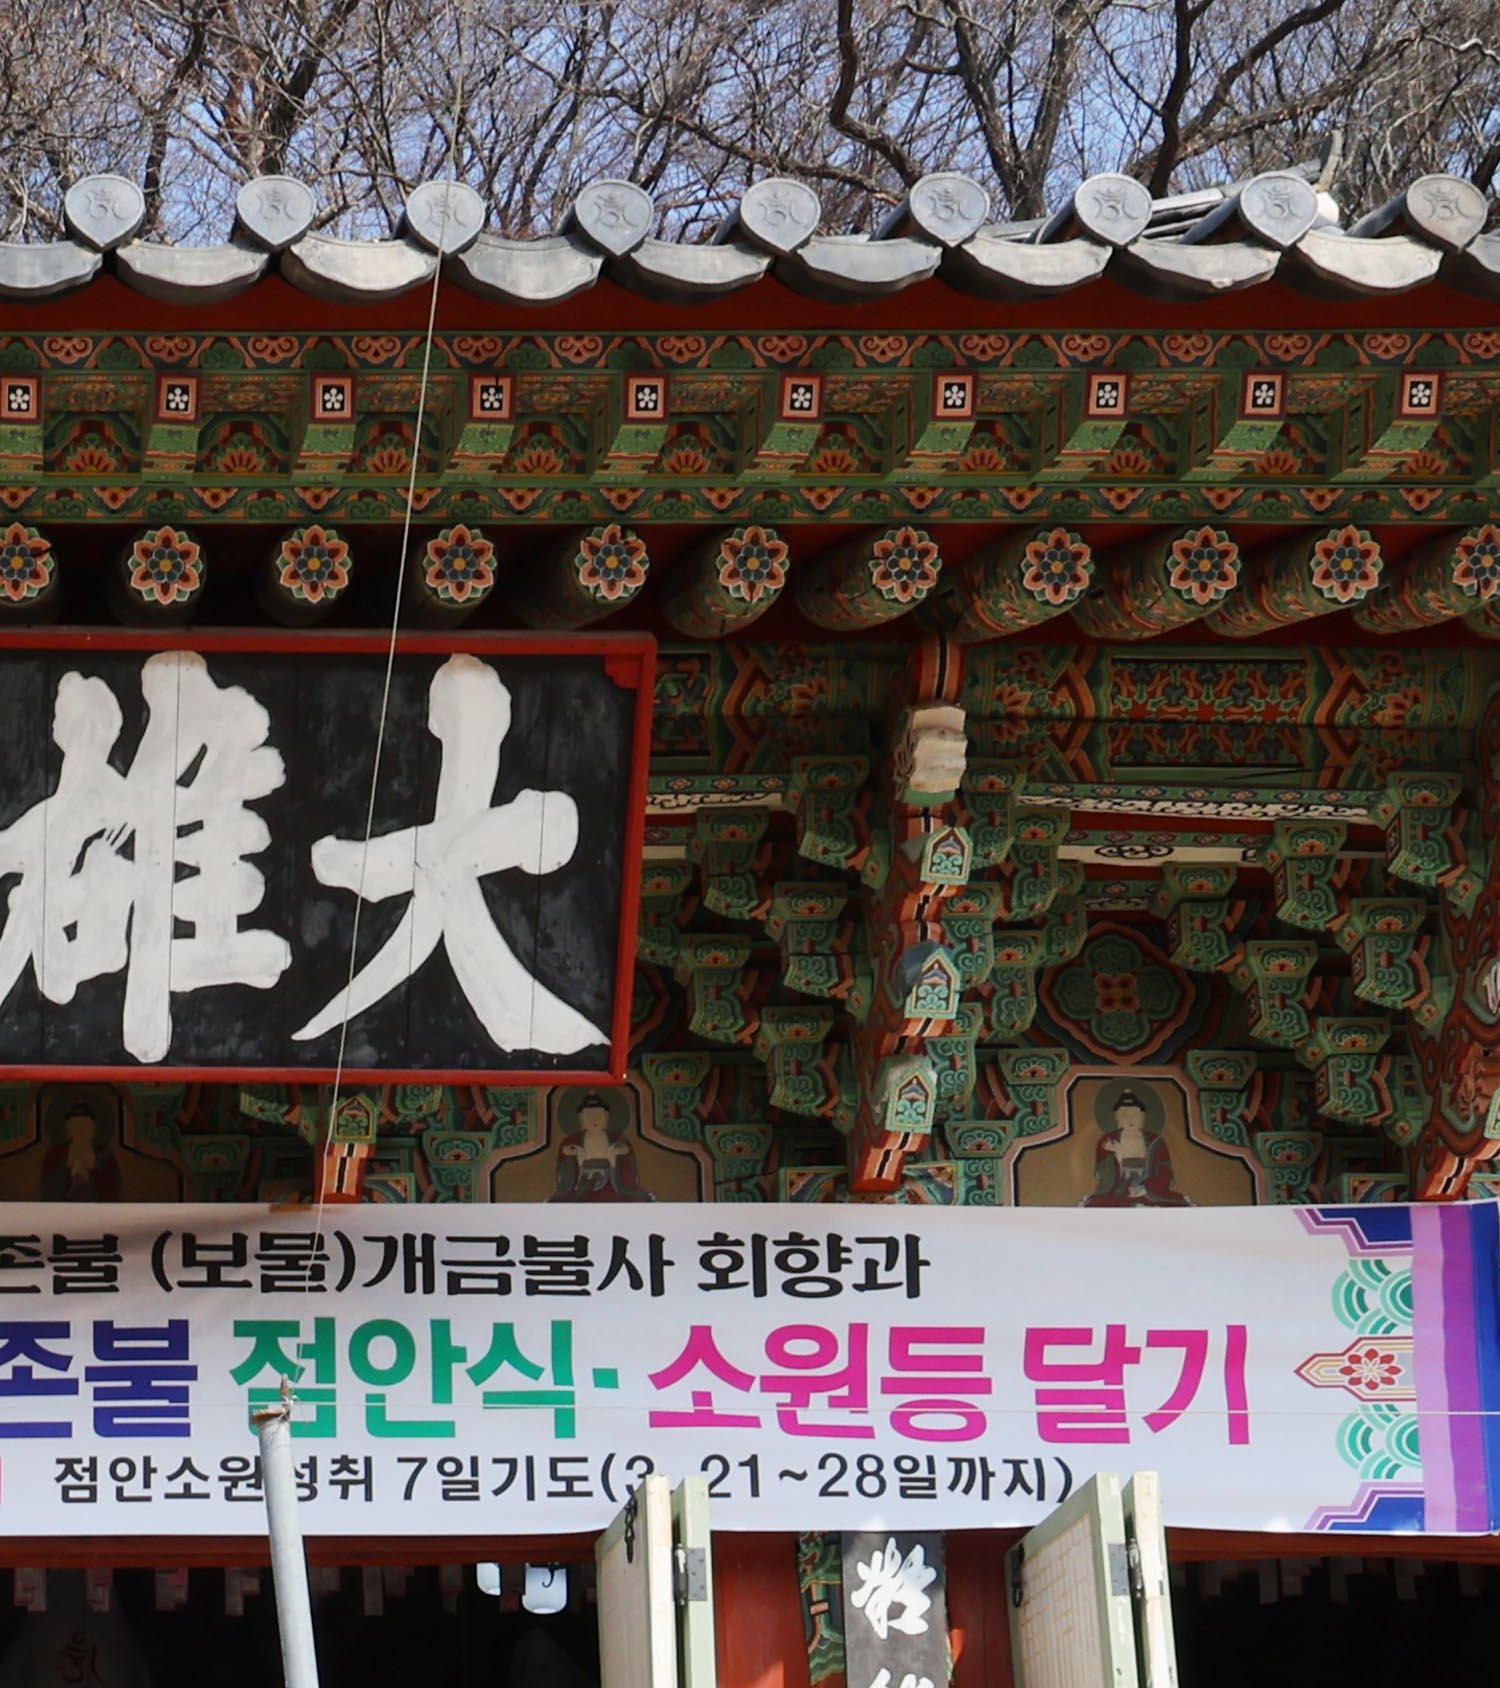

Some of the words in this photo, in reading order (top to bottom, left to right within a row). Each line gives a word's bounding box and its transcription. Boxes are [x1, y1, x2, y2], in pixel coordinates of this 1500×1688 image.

[151, 1229, 675, 1299] (보물)개금불사
[697, 1230, 931, 1299] 회향과
[648, 1322, 994, 1442] 소원등
[1022, 1323, 1251, 1446] 달기
[53, 1454, 374, 1503] 점안소원성취
